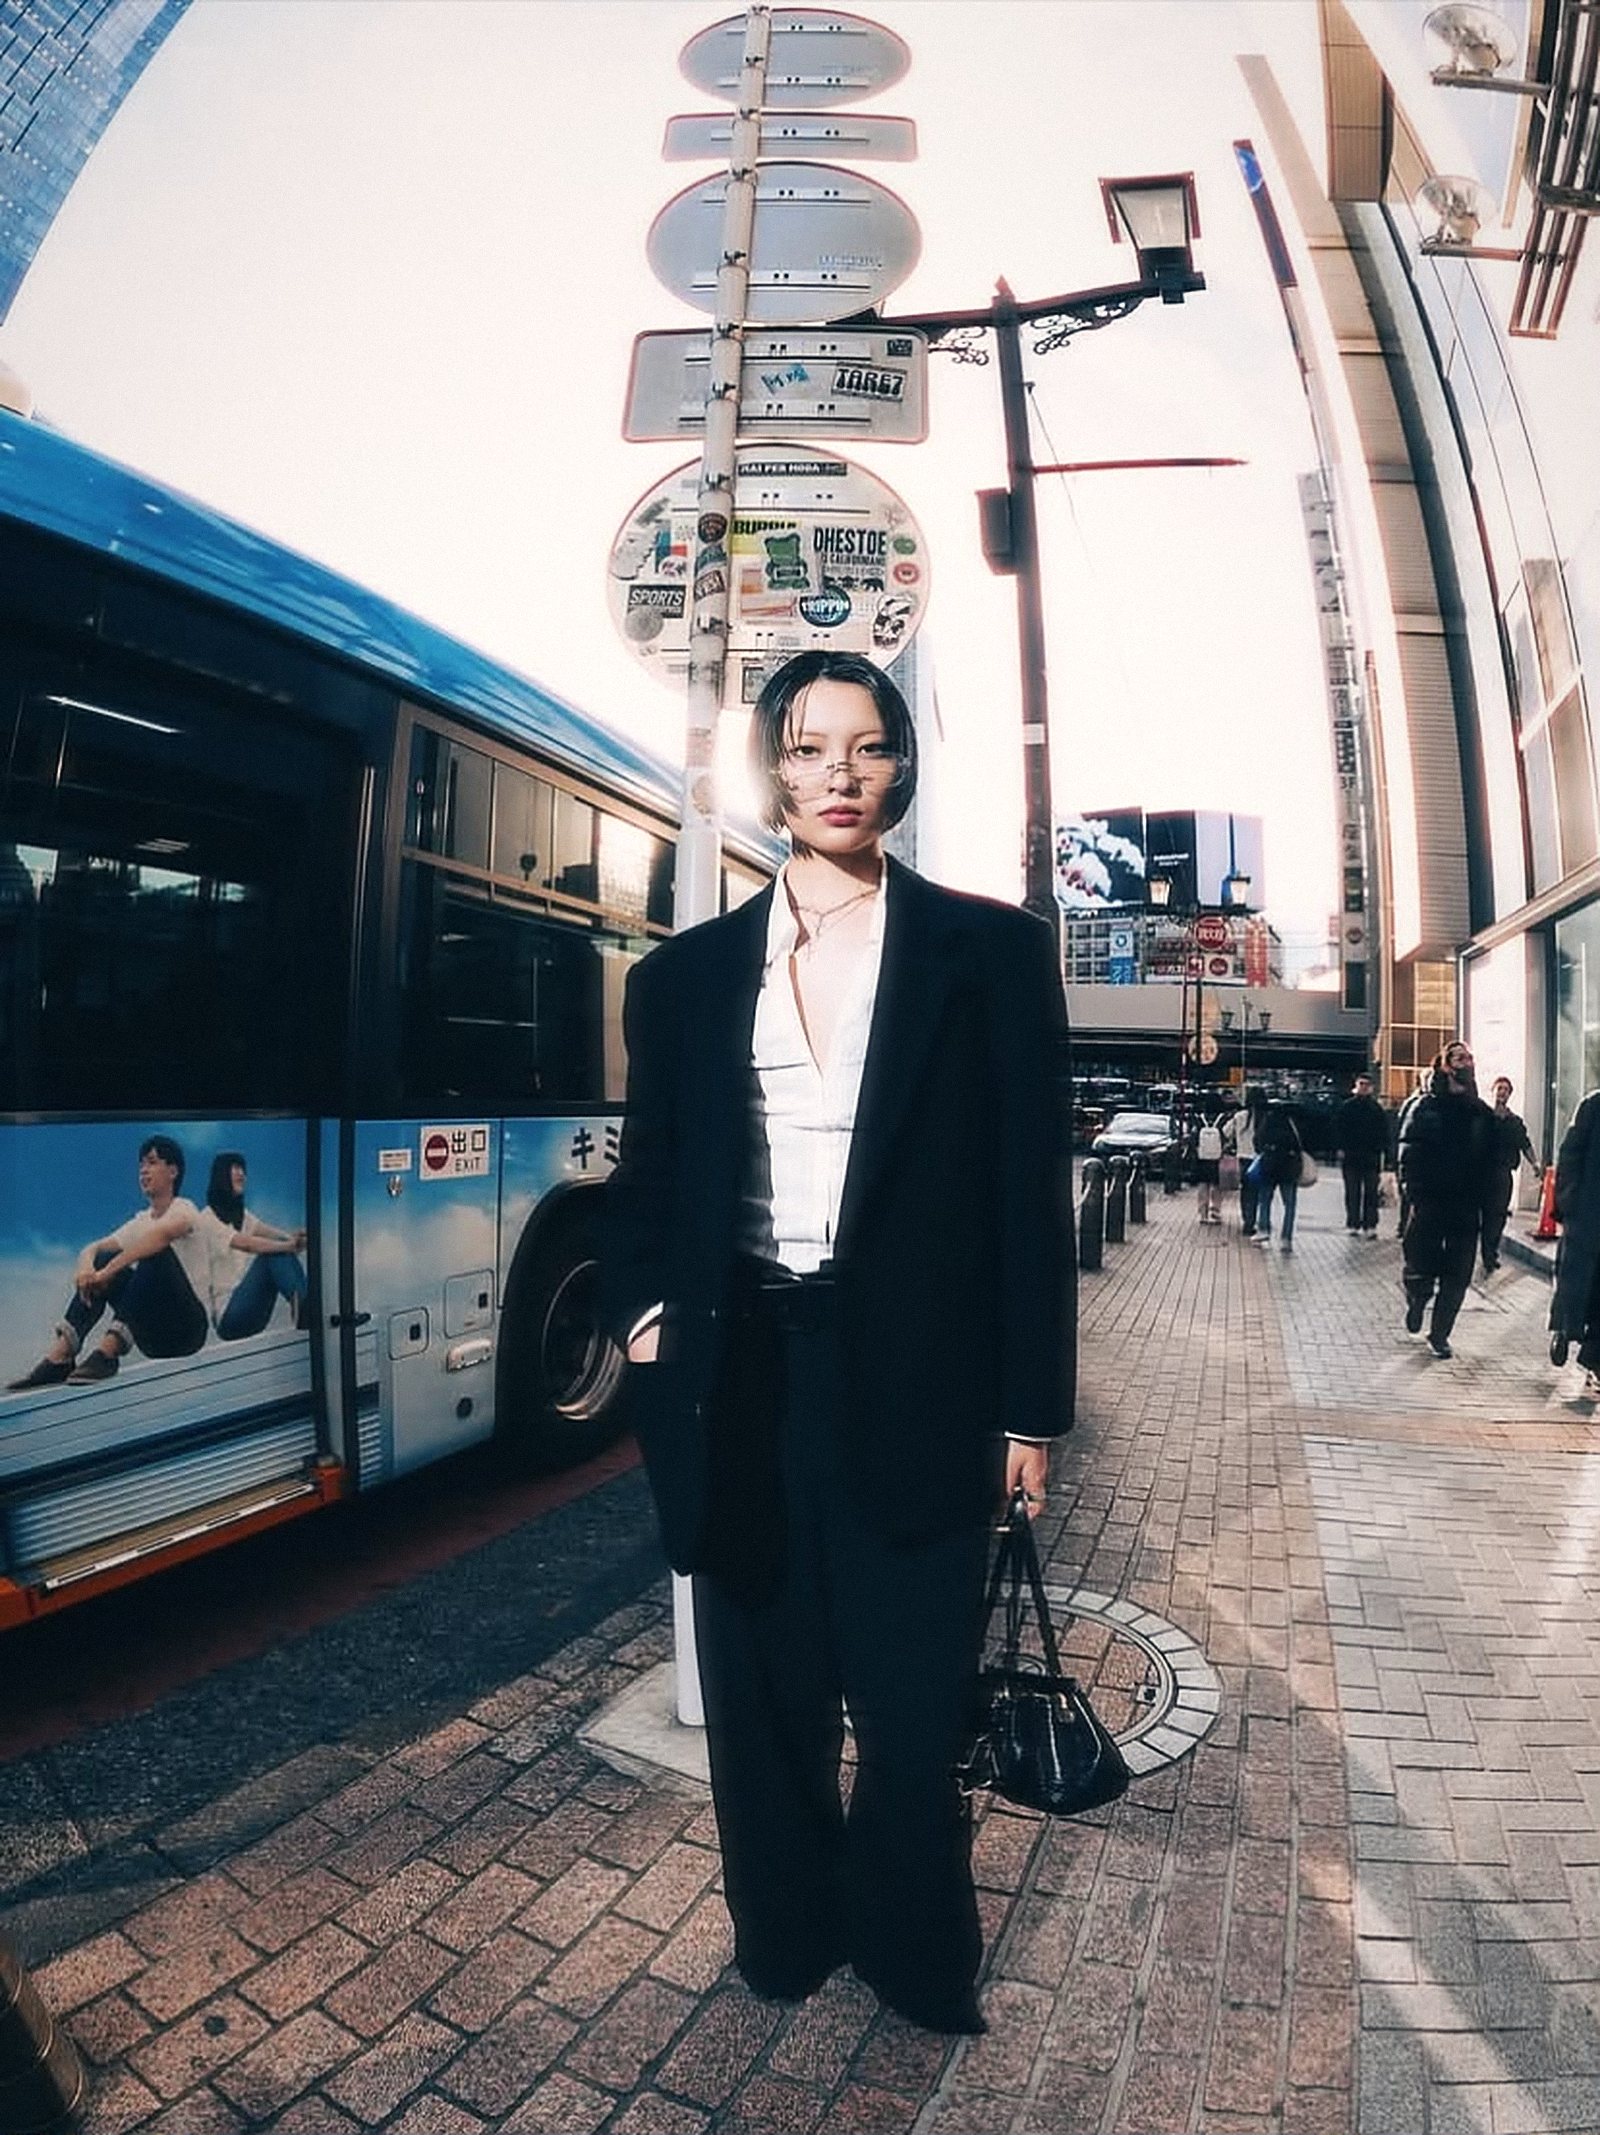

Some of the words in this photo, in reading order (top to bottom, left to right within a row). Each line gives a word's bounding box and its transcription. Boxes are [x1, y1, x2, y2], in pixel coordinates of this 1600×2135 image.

[629, 589, 684, 606] SPORTS
[451, 1129, 486, 1154] 出口
[455, 1157, 480, 1172] EXIT
